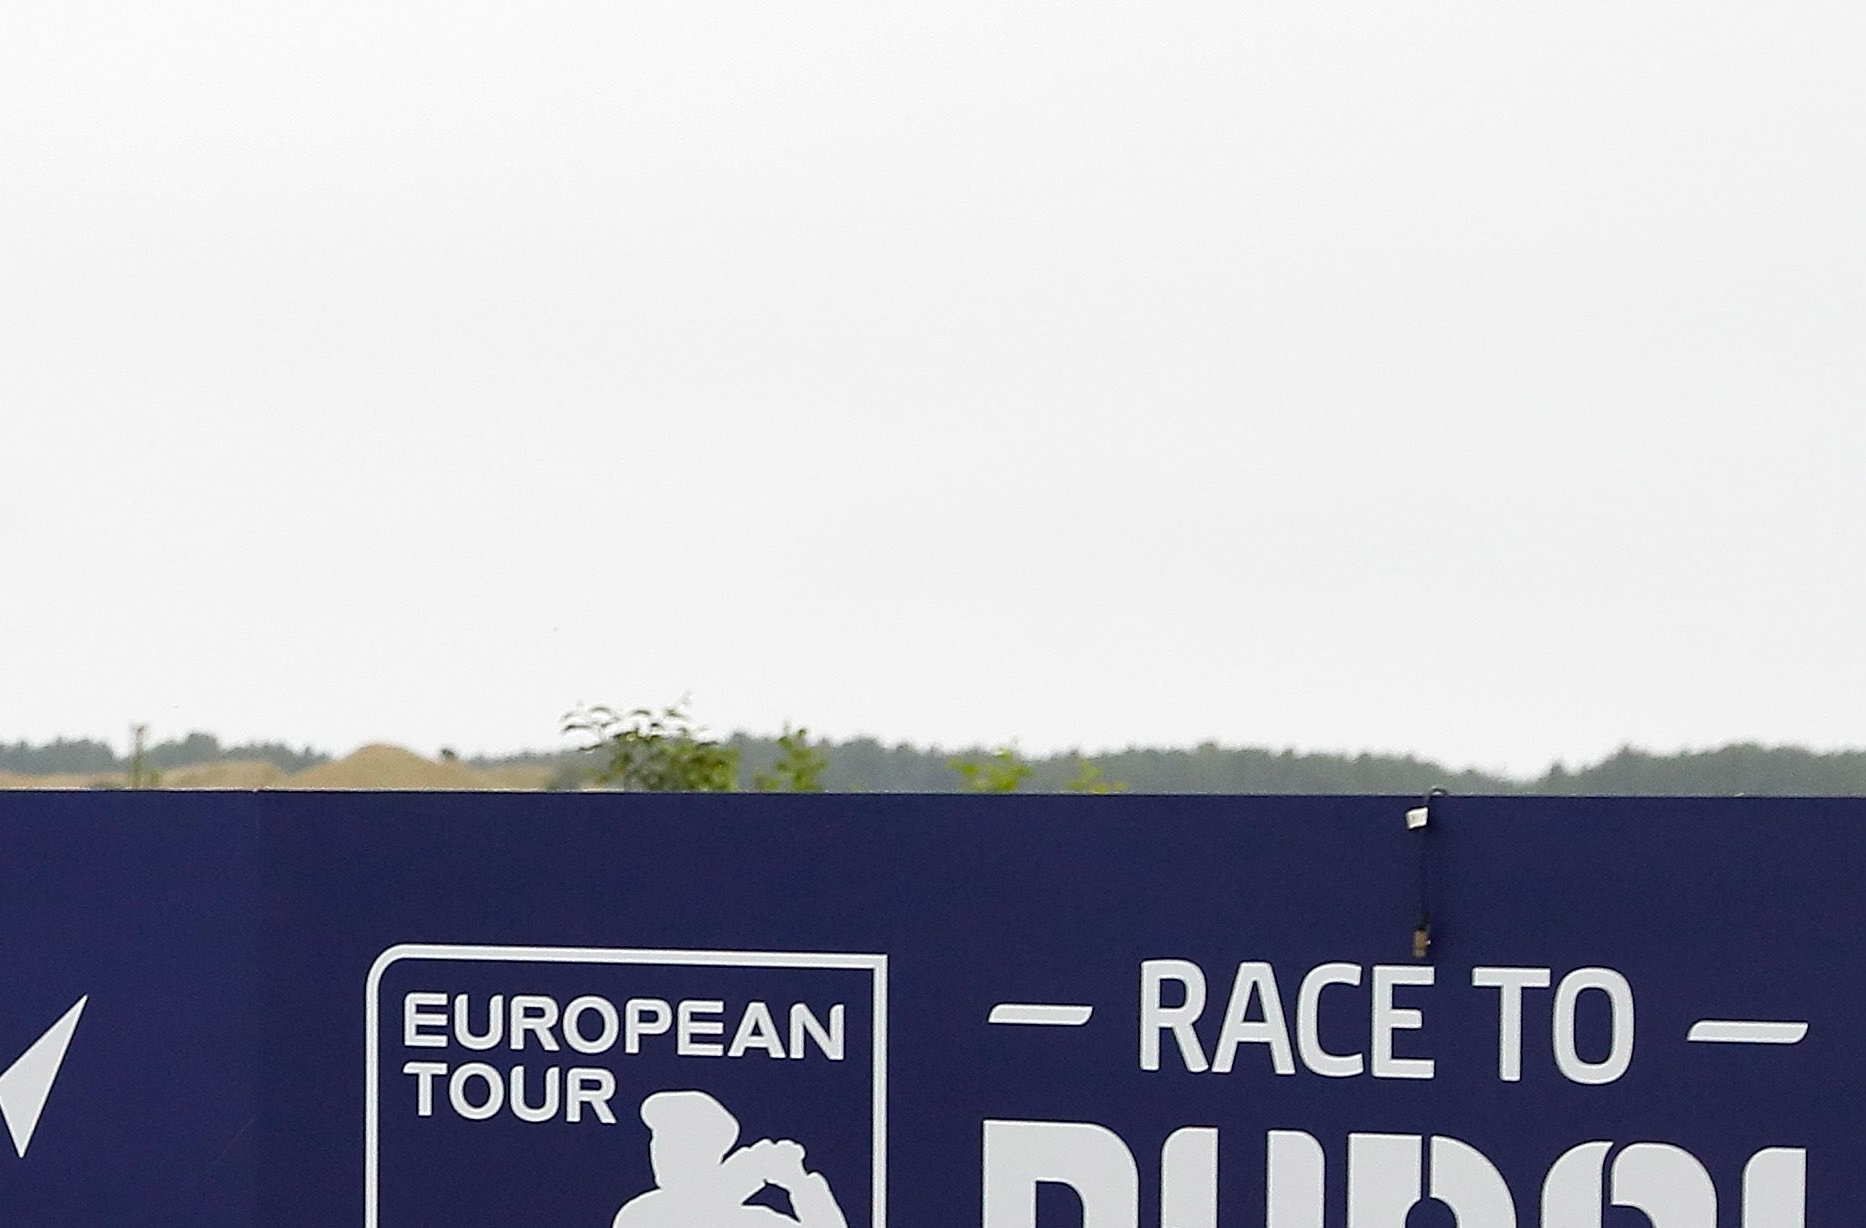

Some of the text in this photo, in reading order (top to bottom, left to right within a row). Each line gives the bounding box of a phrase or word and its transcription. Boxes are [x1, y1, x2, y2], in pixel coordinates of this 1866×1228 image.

[403, 992, 846, 1062] EUROPEAN
[1139, 958, 1636, 1085] RACE TO
[403, 1062, 618, 1124] TOUR
